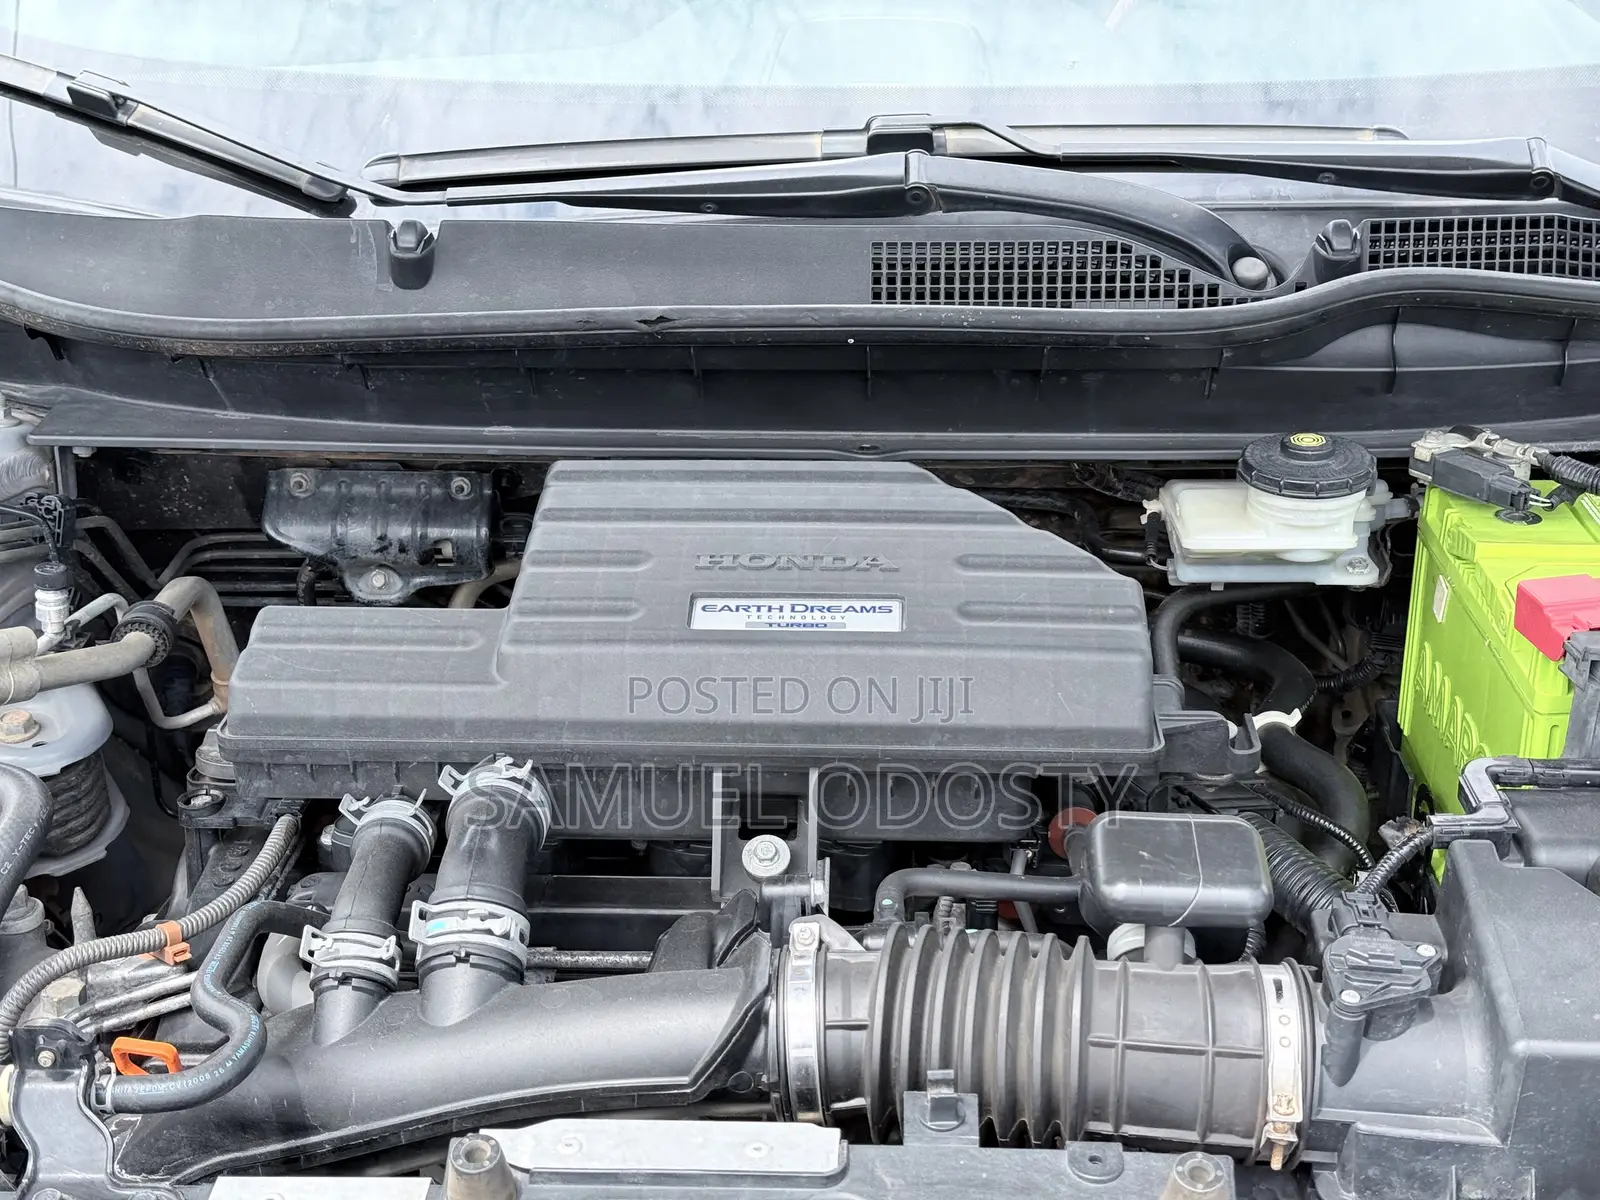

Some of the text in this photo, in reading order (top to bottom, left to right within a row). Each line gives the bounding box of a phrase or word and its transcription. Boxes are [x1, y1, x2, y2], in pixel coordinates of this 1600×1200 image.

[694, 553, 900, 573] HONDA
[701, 603, 893, 614] EARTH DREAMS
